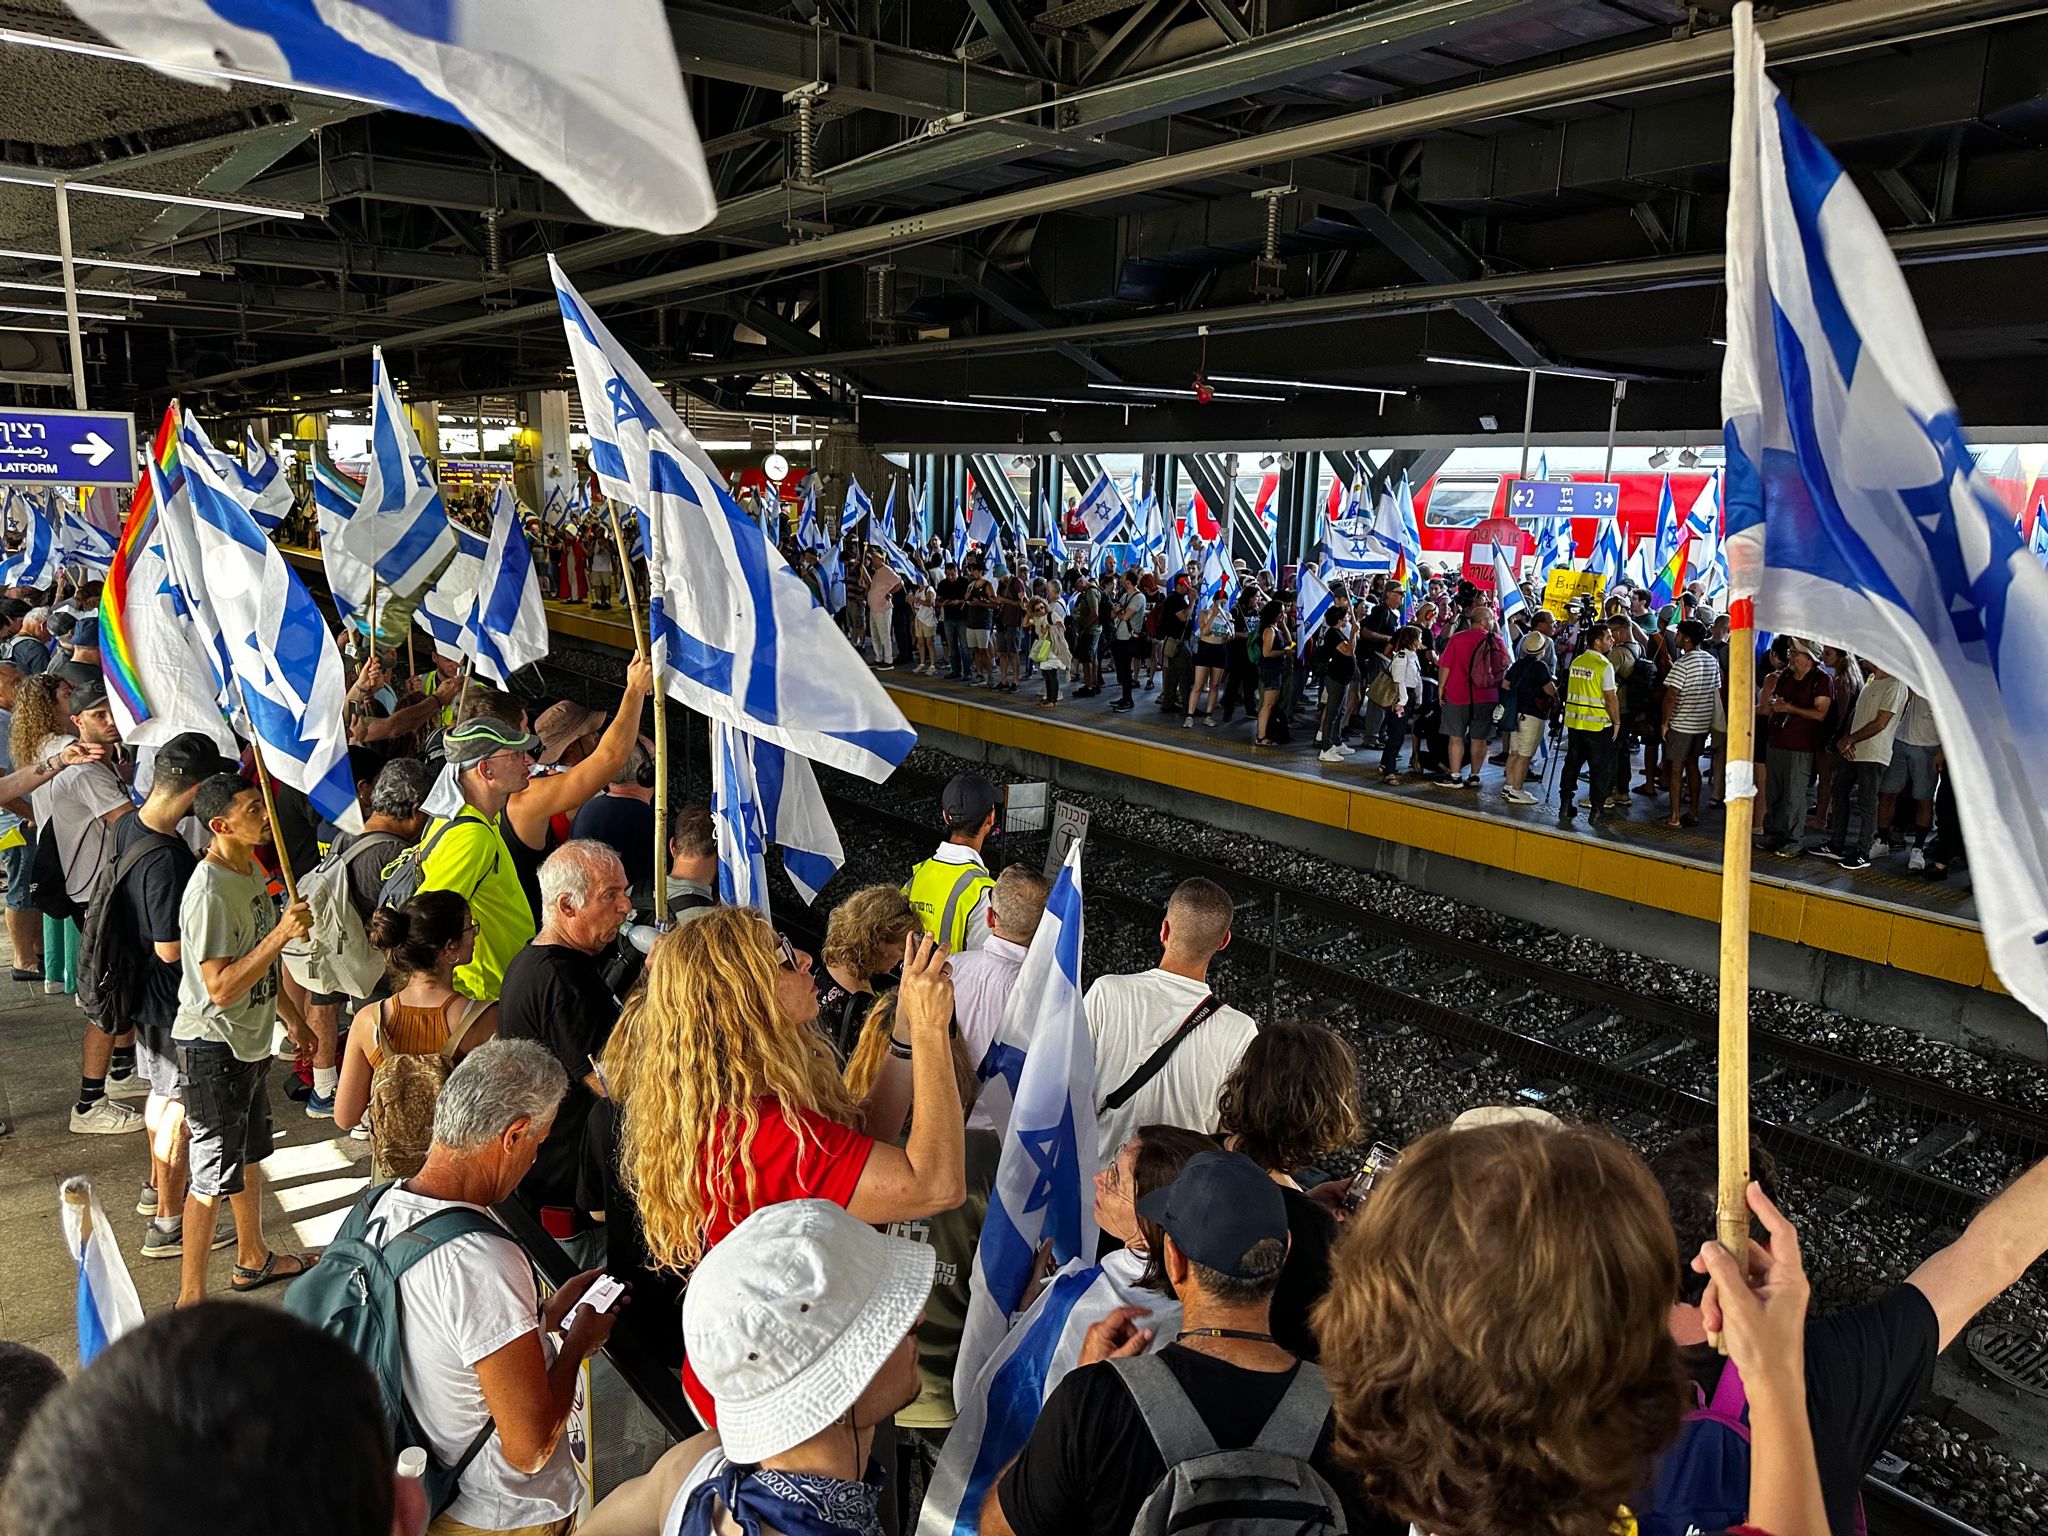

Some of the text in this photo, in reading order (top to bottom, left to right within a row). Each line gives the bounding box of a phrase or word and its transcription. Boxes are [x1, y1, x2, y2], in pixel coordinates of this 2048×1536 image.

[0, 463, 58, 473] LATFORM
[1525, 488, 1534, 507] 2
[1593, 491, 1602, 509] 3
[1057, 804, 1087, 826] סכנה!
